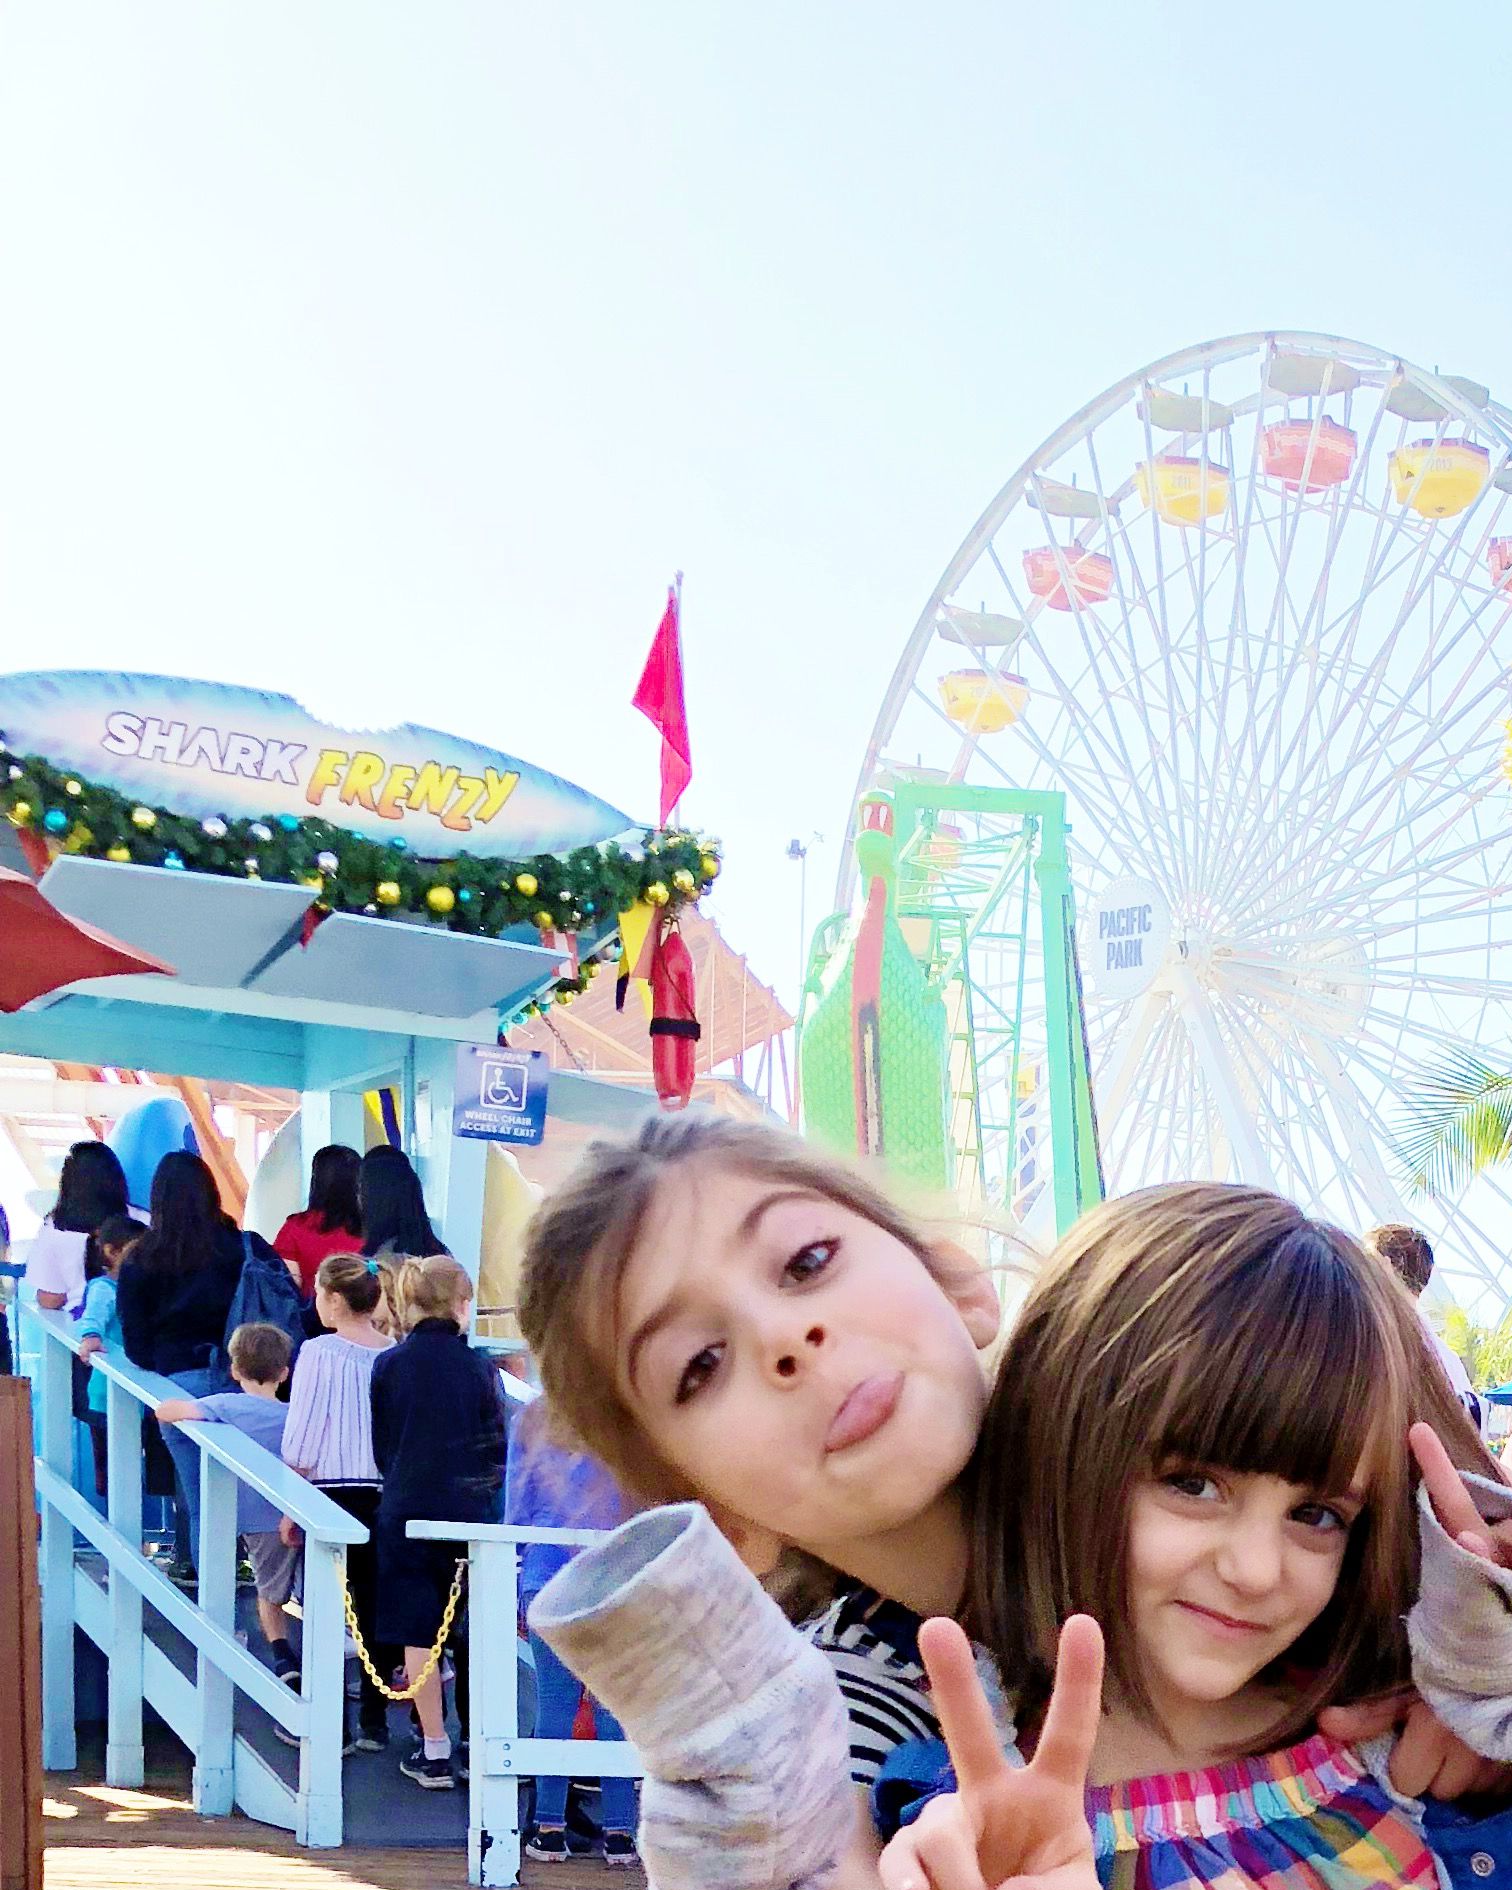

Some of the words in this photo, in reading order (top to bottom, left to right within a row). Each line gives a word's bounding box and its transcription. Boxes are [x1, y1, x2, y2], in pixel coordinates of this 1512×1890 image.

[101, 711, 307, 786] SHARK
[305, 748, 521, 832] FRENZY
[1100, 904, 1153, 940] PACIFIC
[1106, 938, 1144, 971] PARK
[460, 1121, 498, 1134] ACCESS
[499, 1125, 512, 1135] AT
[512, 1127, 537, 1138] EXIT
[464, 1110, 499, 1122] WHEEL
[500, 1114, 532, 1126] CHAIR
